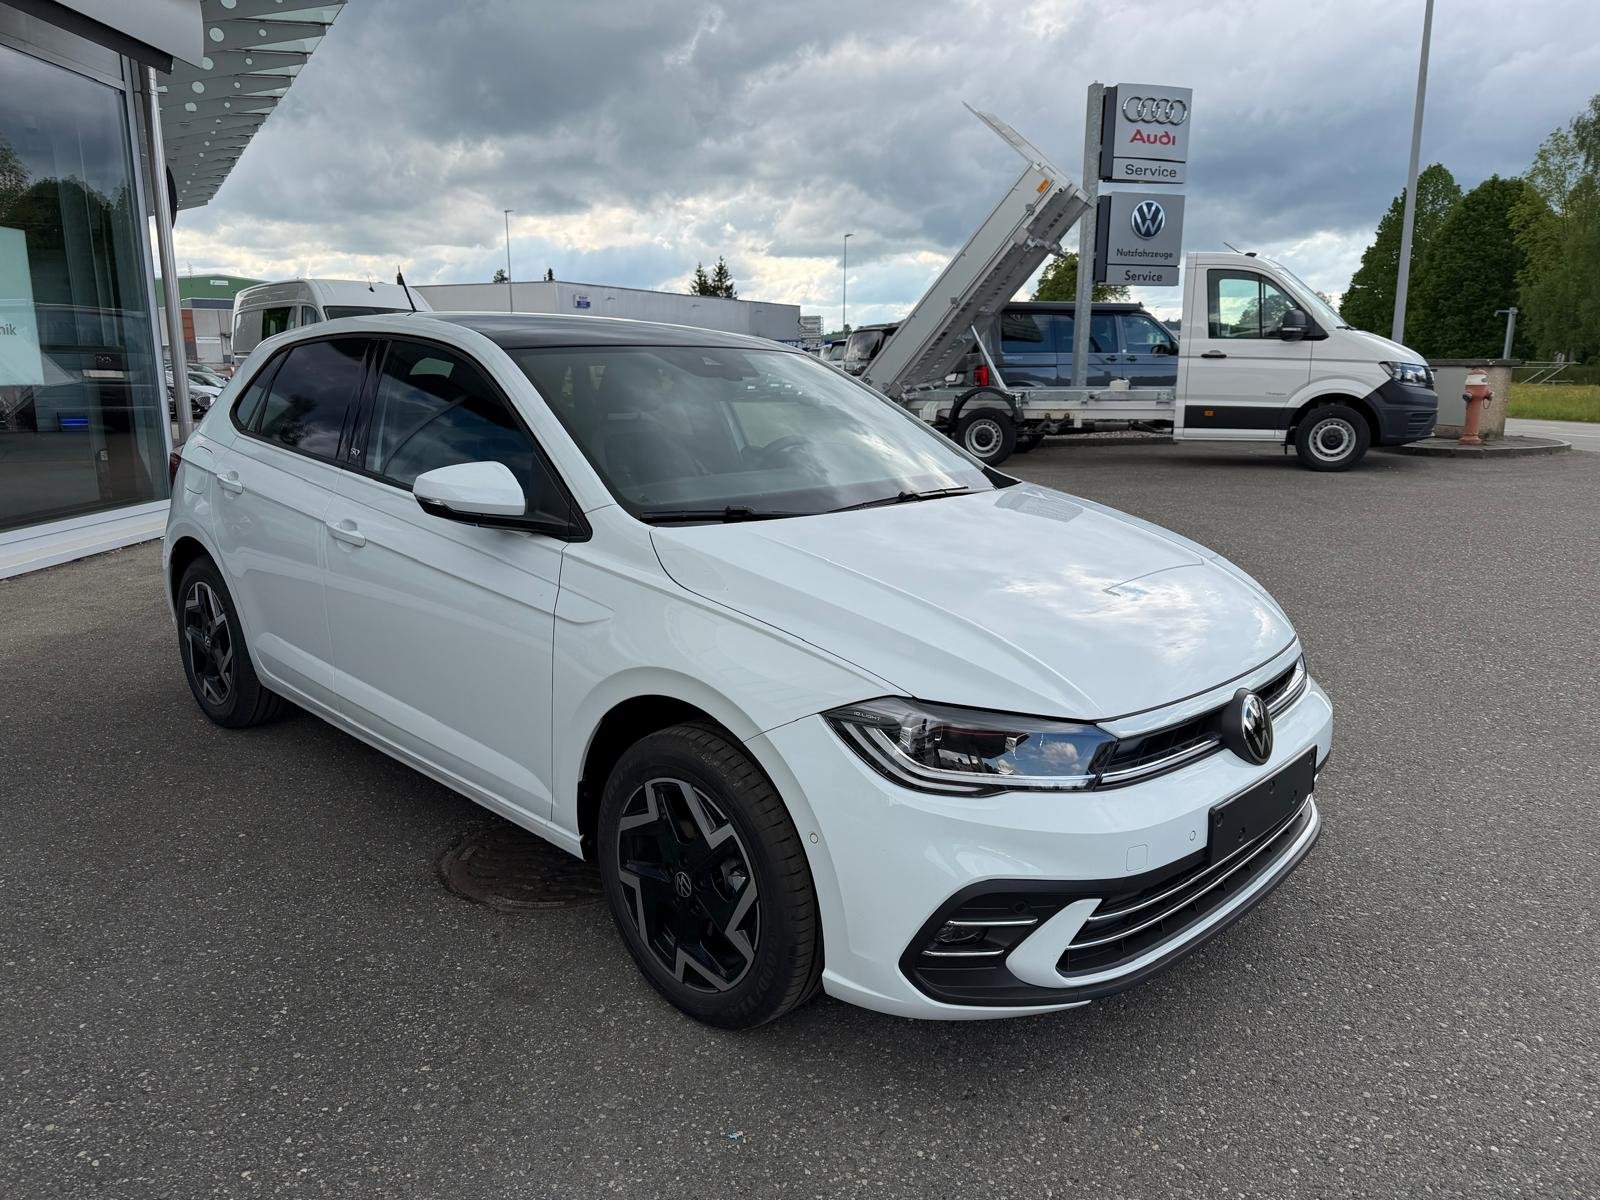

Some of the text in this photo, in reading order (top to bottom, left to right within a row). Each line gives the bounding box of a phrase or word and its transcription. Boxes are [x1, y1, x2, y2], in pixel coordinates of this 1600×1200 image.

[1129, 129, 1176, 146] Audi
[1124, 163, 1177, 178] Service
[1116, 248, 1174, 261] Nutzfahrzeuge
[1124, 270, 1163, 282] Service
